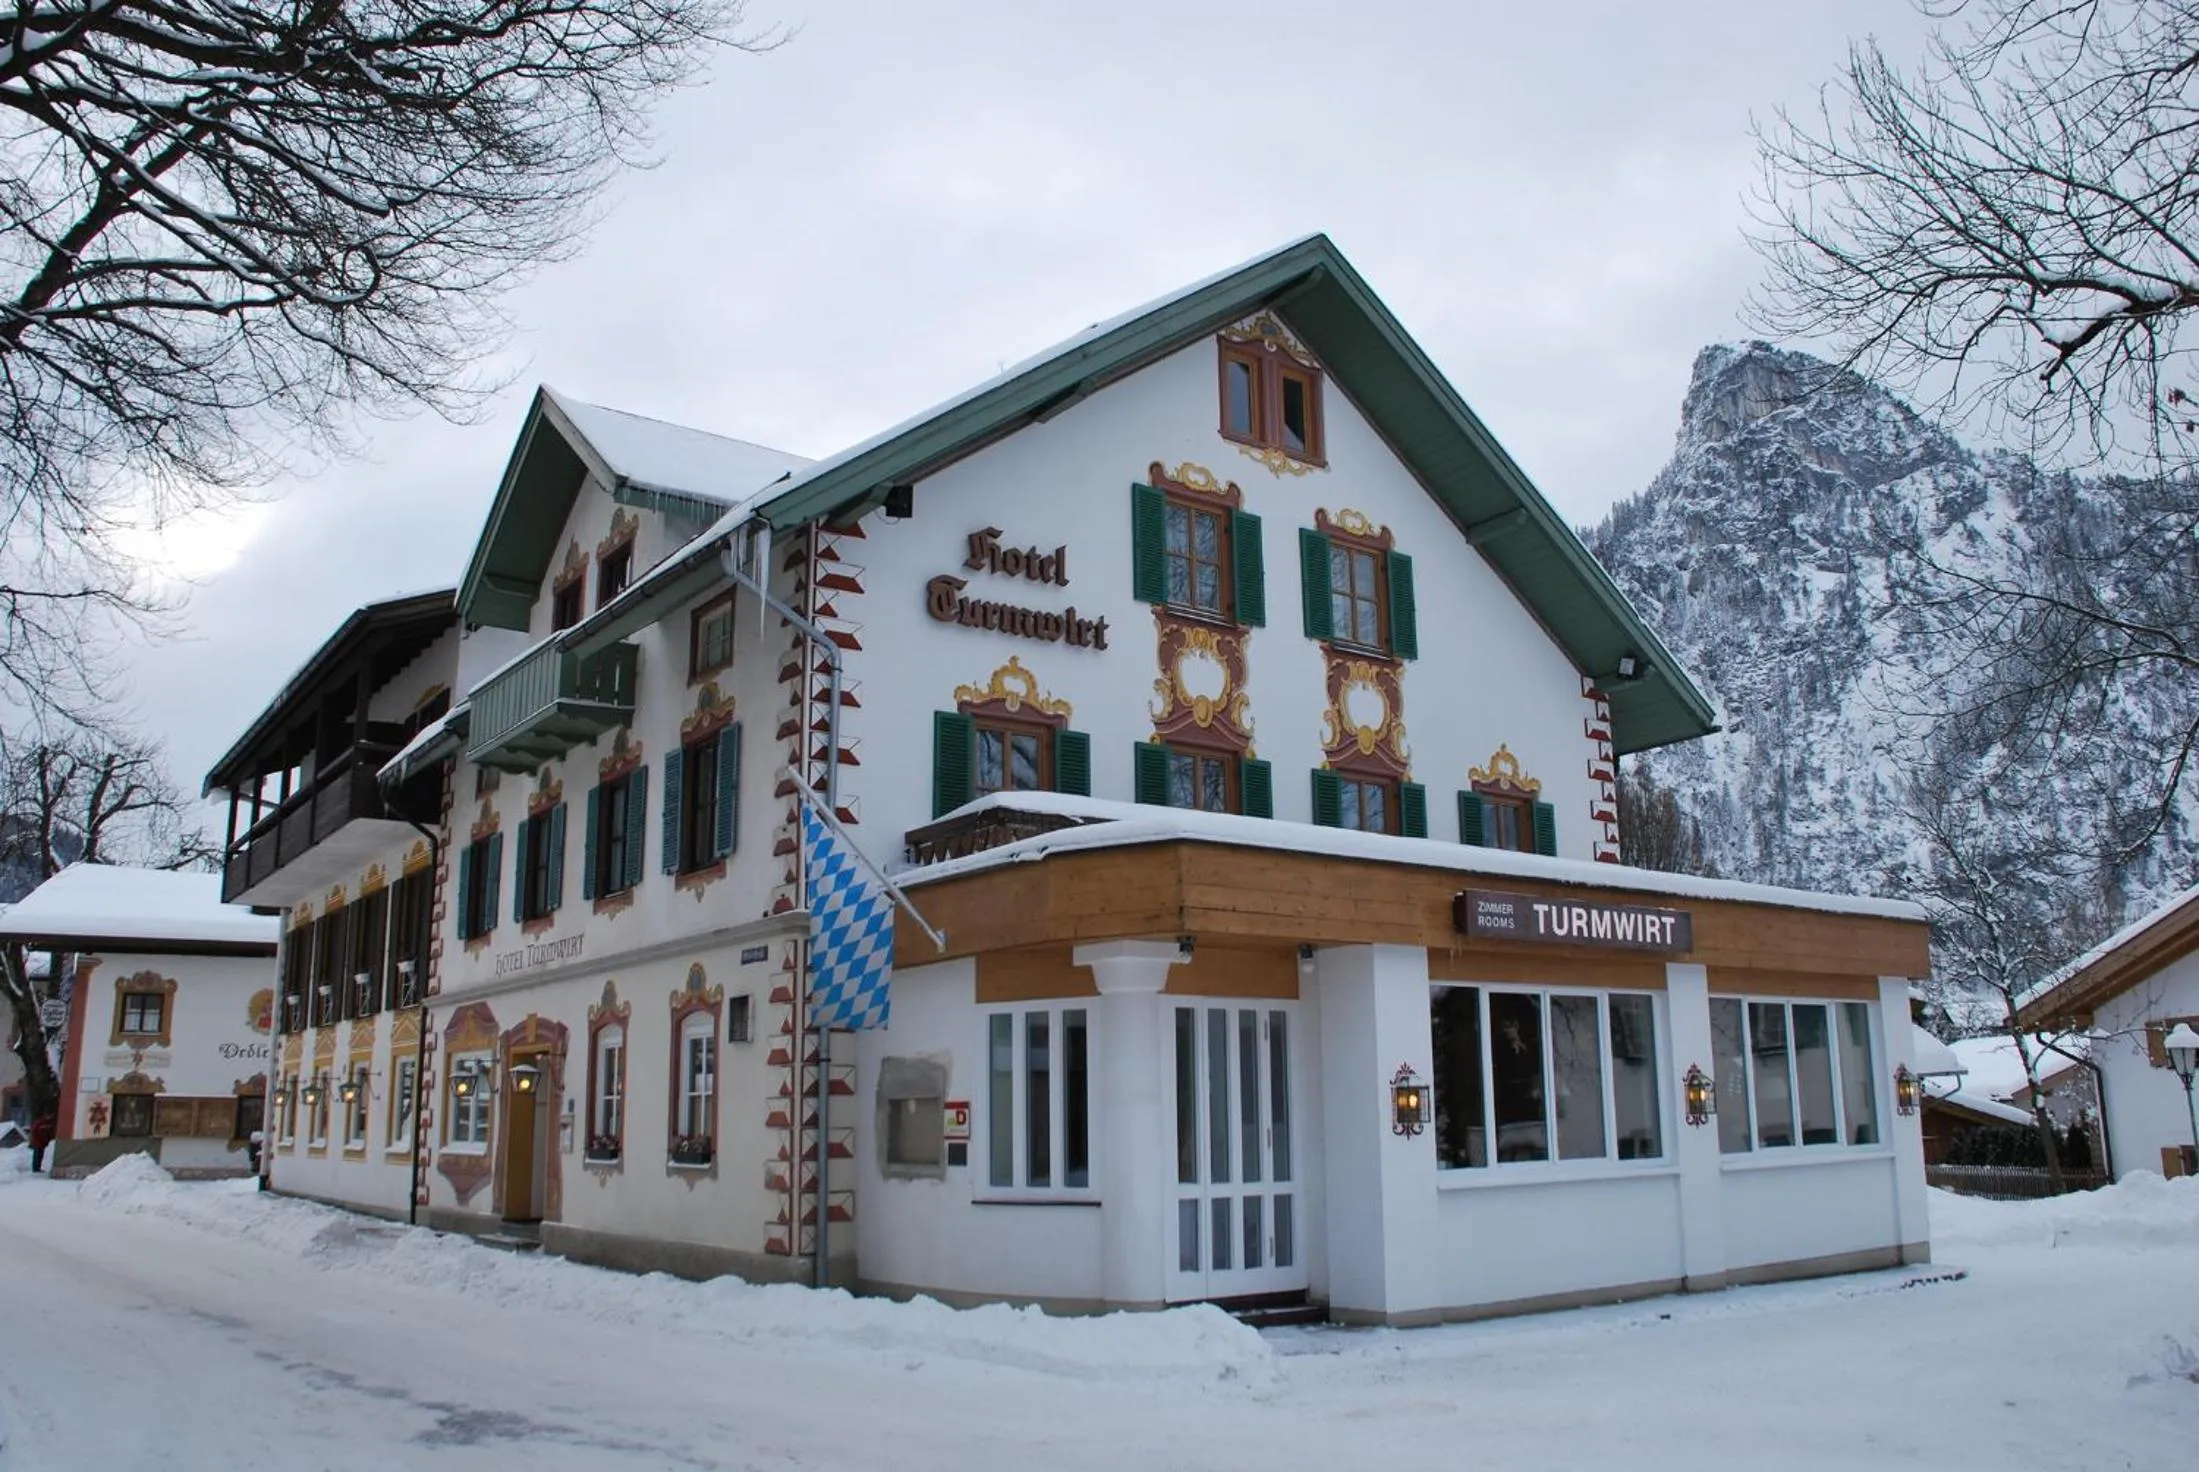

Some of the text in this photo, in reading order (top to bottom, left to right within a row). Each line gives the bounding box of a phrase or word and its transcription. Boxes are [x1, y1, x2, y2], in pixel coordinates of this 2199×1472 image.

[963, 526, 1069, 587] Hotel
[927, 574, 1110, 651] Turmwirt
[1477, 901, 1514, 914] ZIMMER
[1478, 916, 1515, 929] ROOMS
[1533, 903, 1675, 945] TURMWIRT
